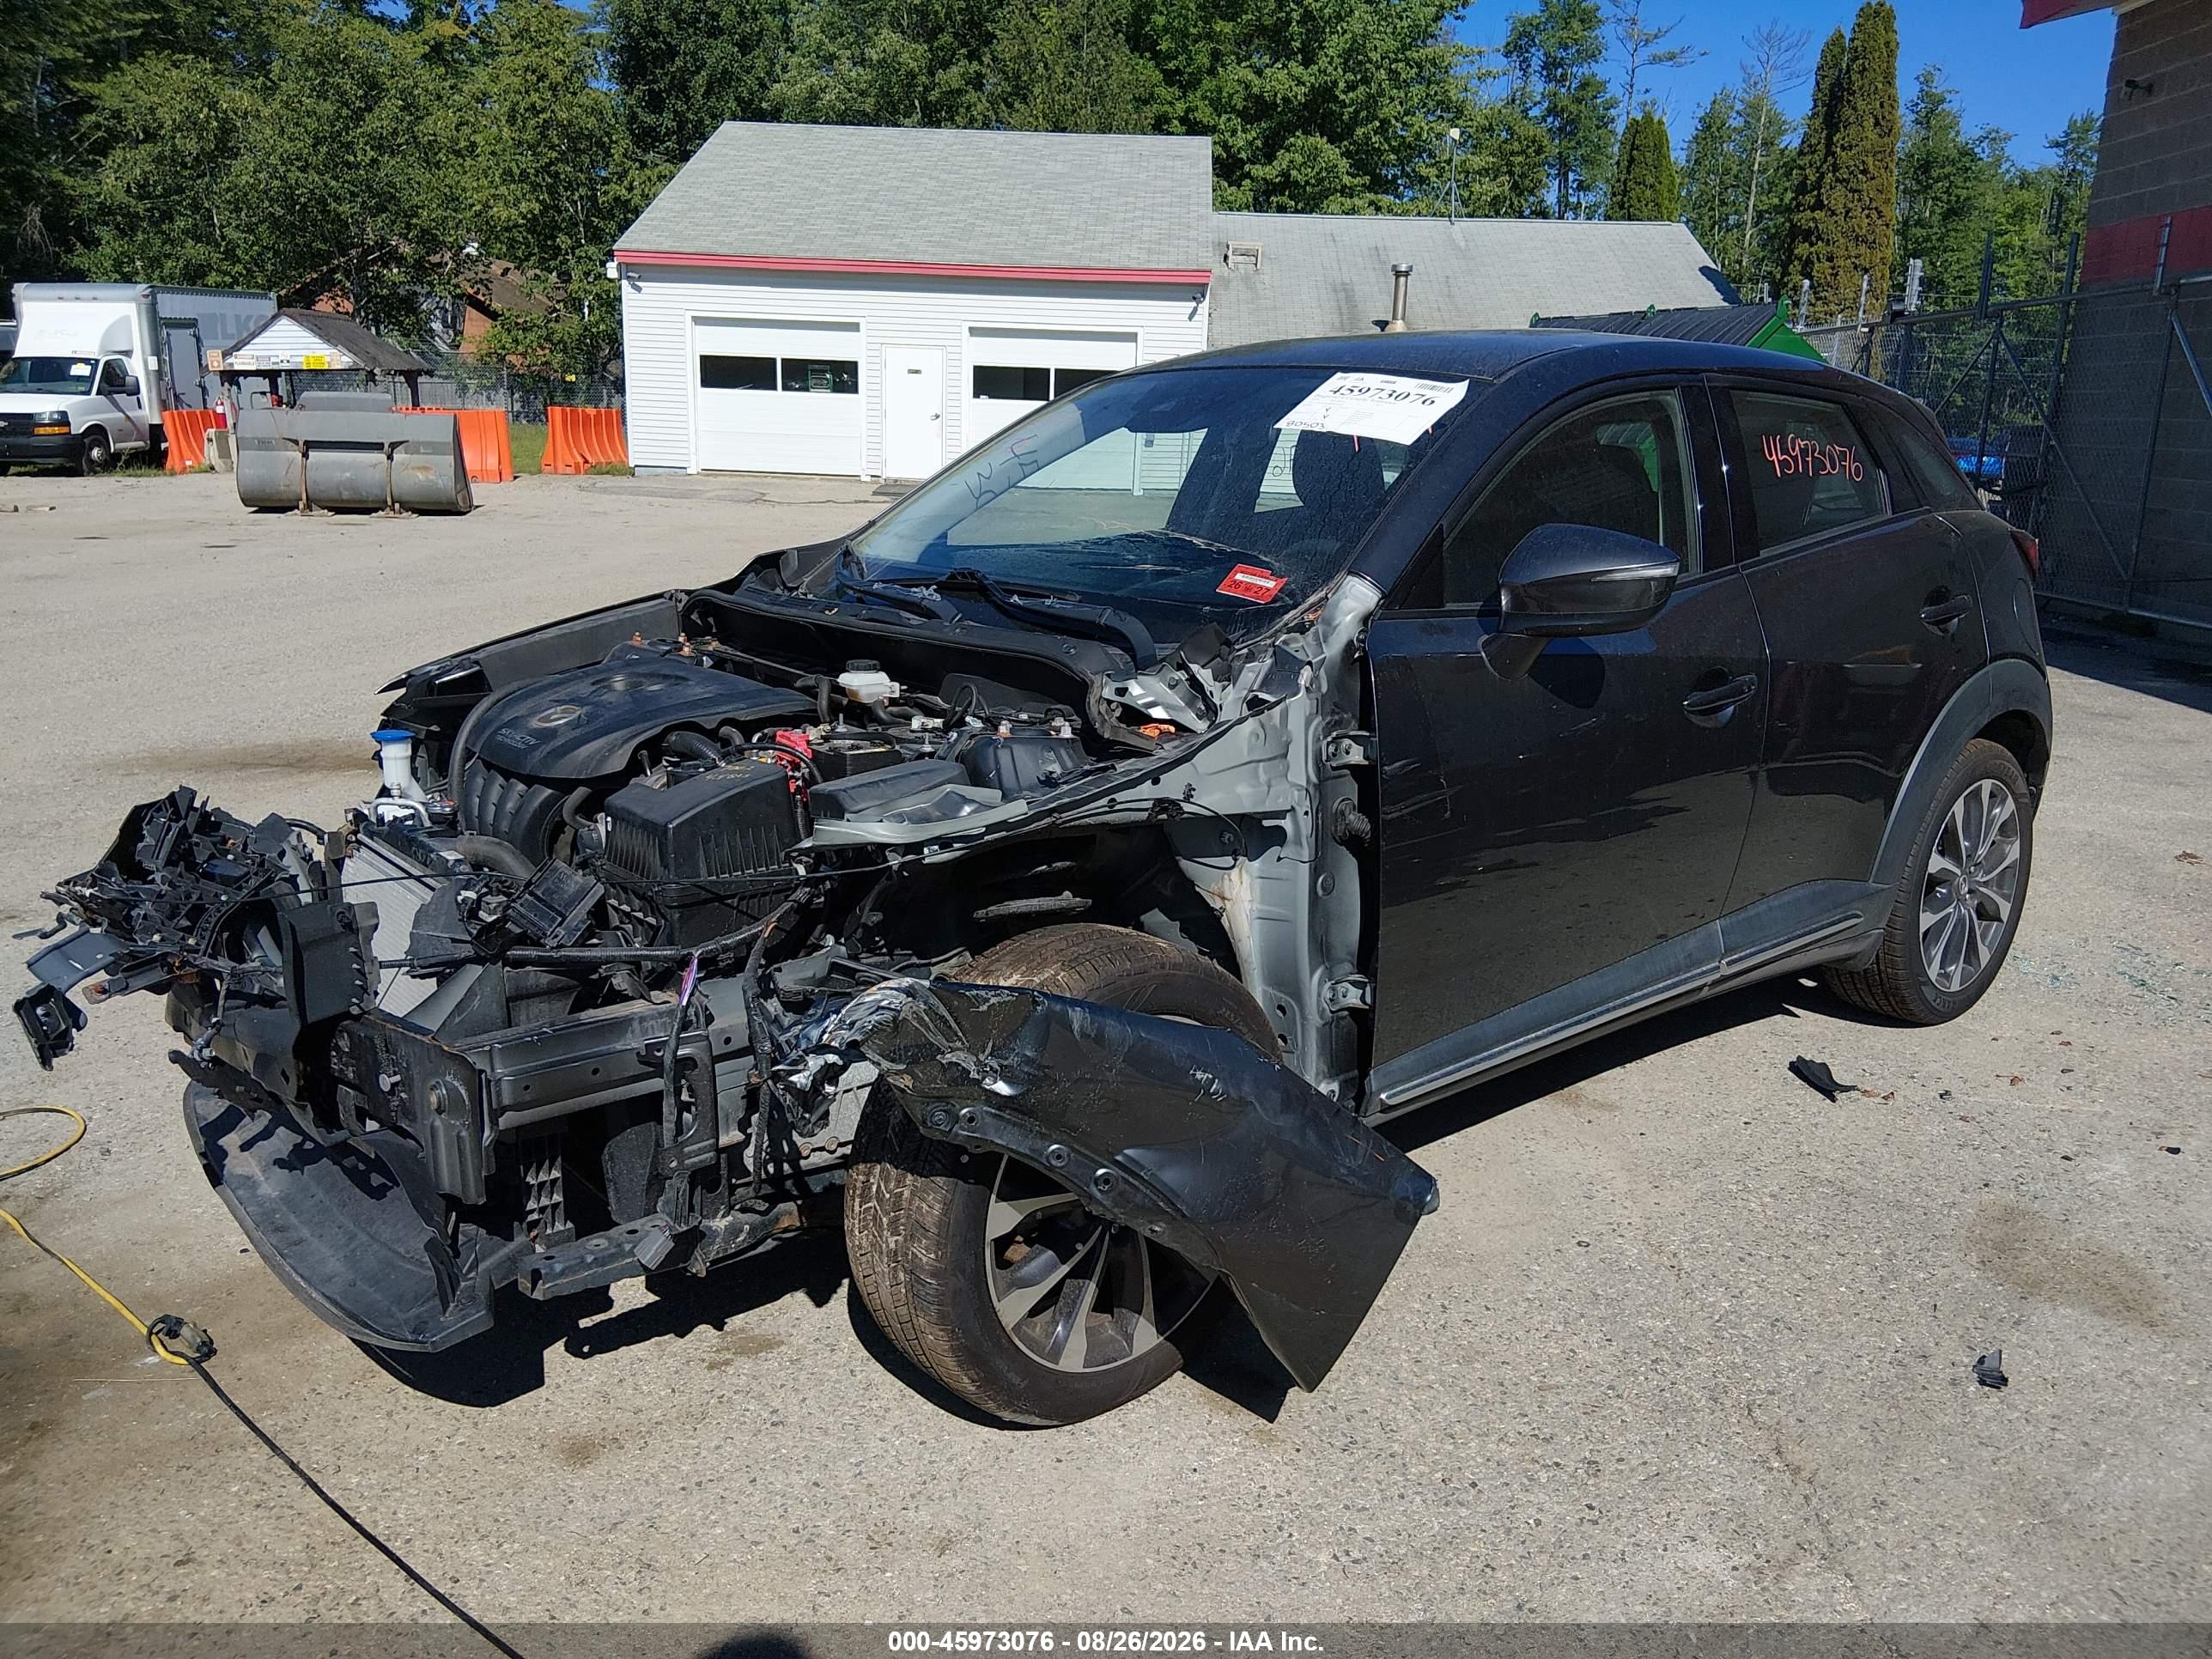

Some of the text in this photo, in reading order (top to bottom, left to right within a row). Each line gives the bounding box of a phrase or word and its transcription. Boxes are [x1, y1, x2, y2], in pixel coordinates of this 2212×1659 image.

[1328, 385, 1439, 406] 45973076
[1762, 433, 1863, 481] 45973076
[1227, 580, 1243, 590] 26
[1254, 586, 1271, 596] 27
